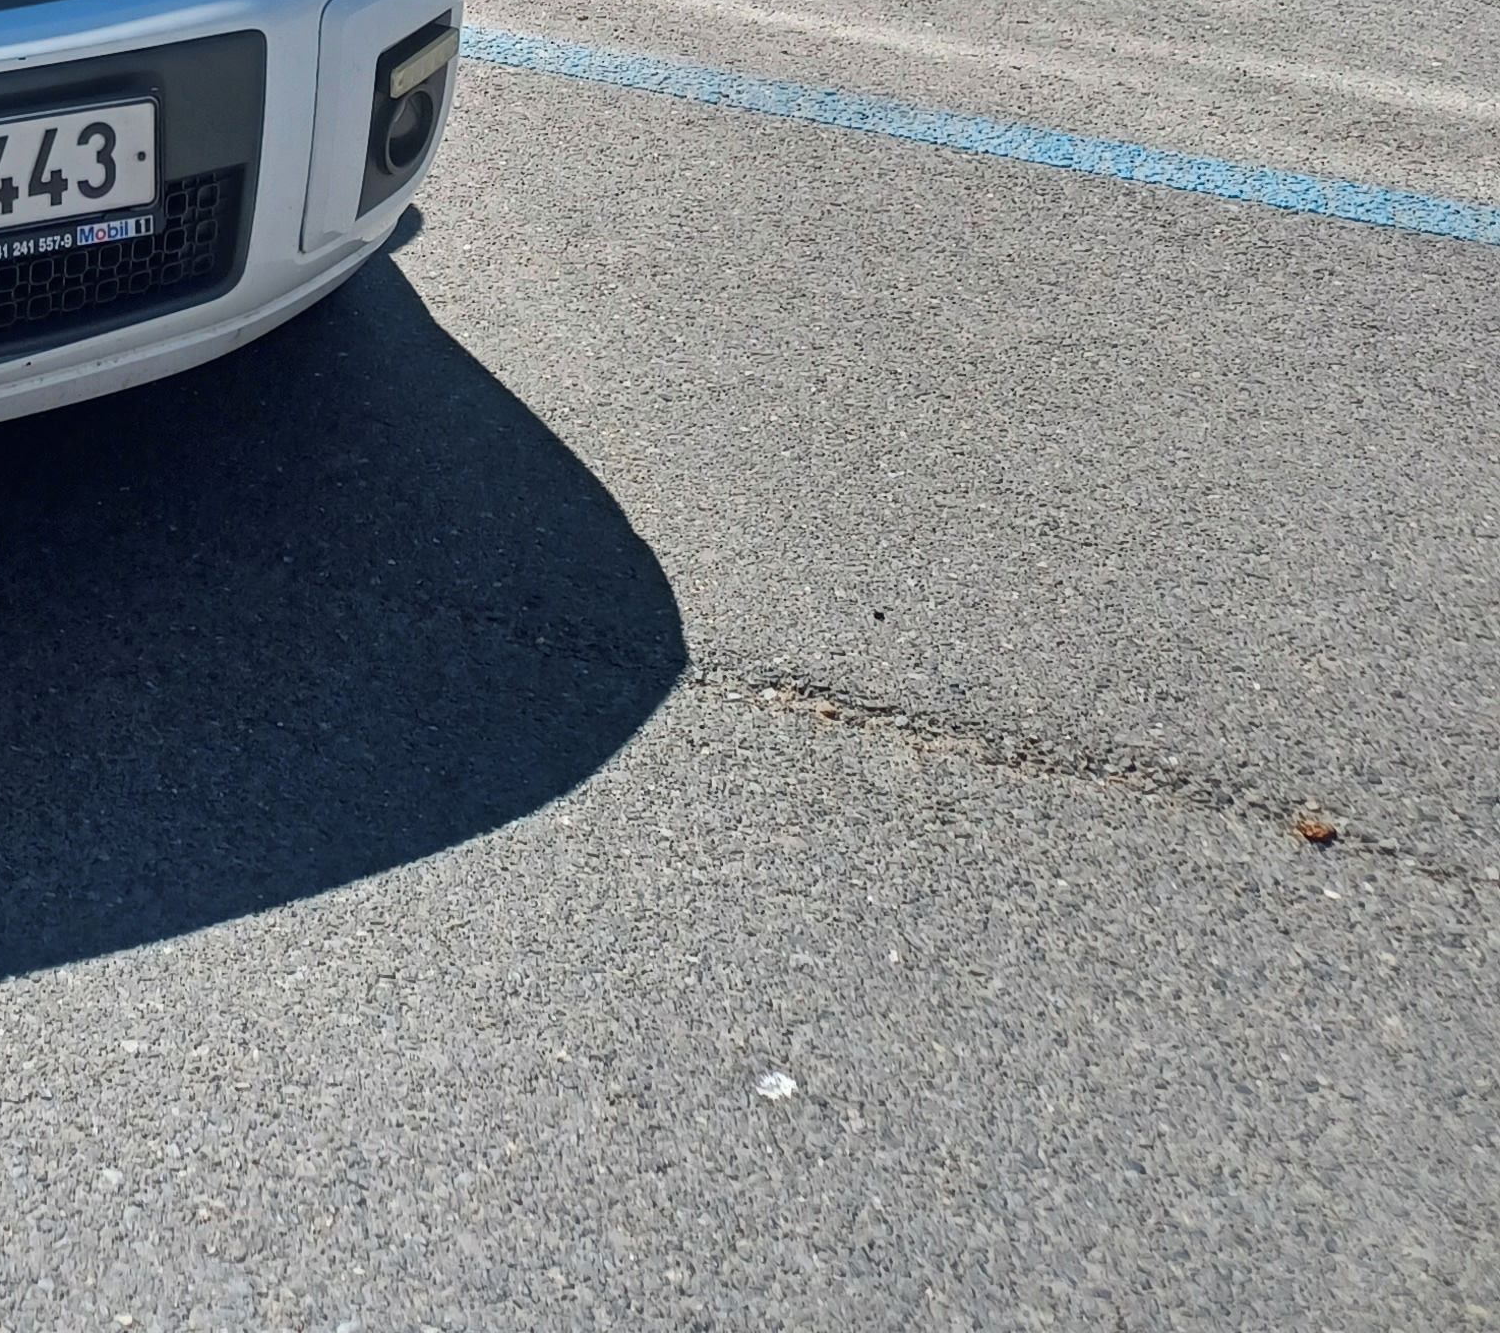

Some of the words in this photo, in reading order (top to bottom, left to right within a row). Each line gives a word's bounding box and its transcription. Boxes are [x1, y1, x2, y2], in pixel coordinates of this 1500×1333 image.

[13, 239, 34, 255] 241
[39, 233, 73, 253] 557-9
[79, 220, 130, 244] Mobil
